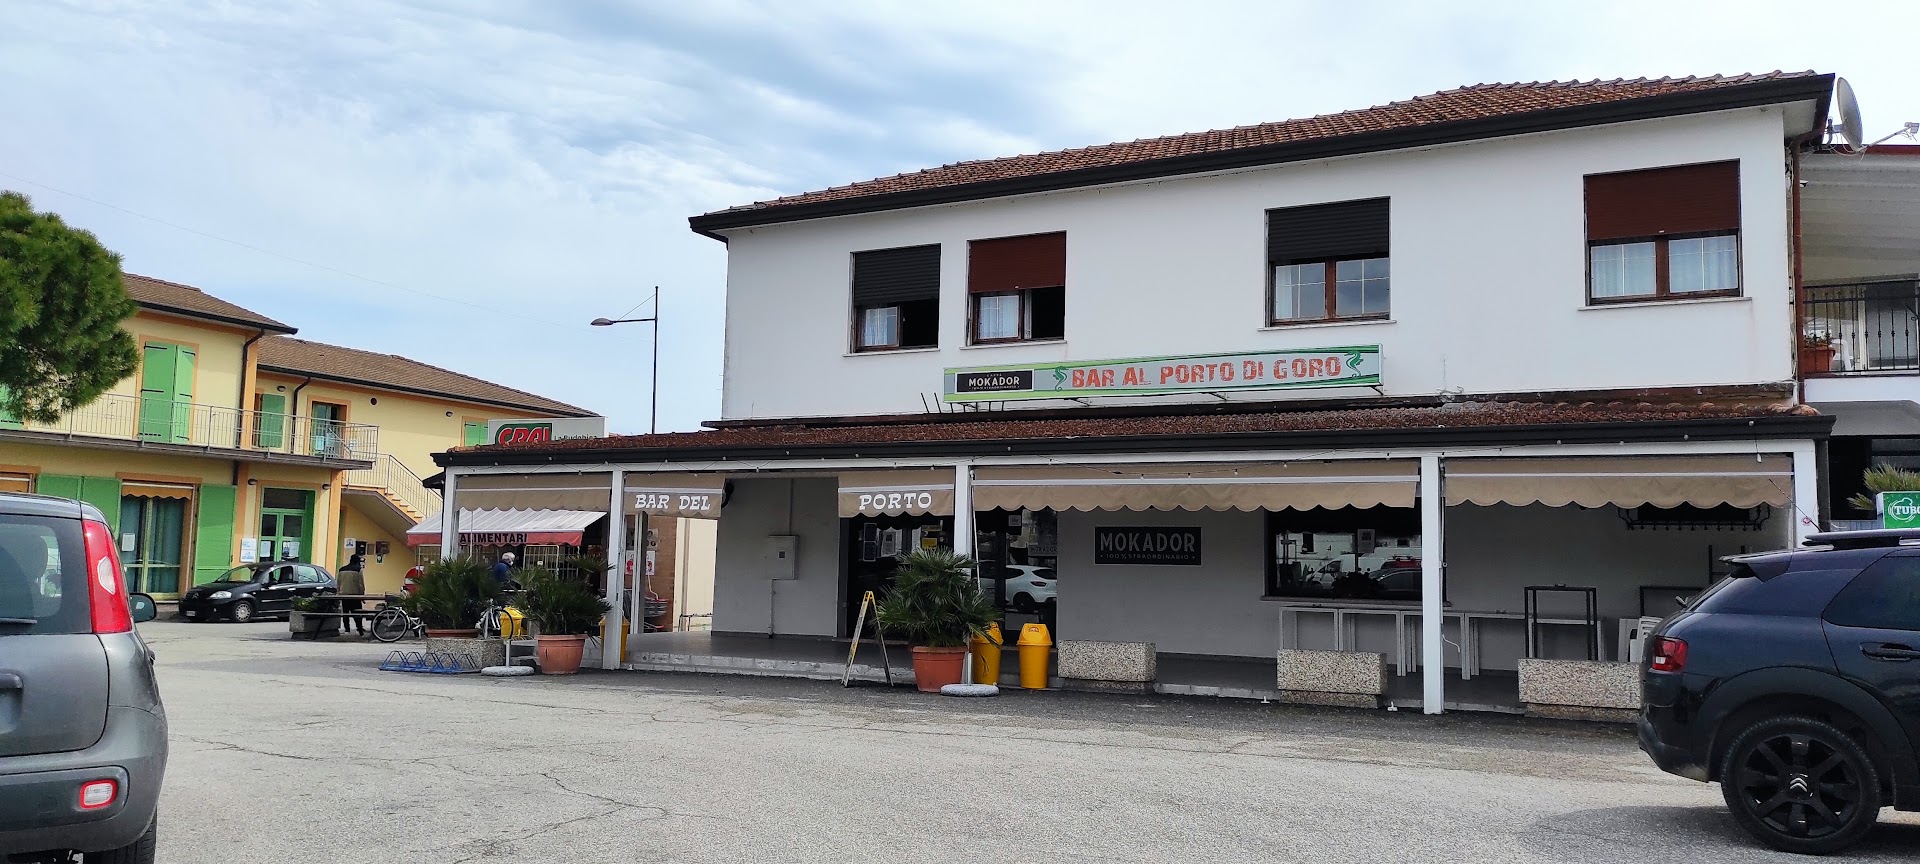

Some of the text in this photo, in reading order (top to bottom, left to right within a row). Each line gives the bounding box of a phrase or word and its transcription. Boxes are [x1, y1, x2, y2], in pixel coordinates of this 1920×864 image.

[1072, 356, 1342, 388] BAR AL PORTO DI GORO
[968, 376, 1021, 387] MOKADOR
[635, 494, 711, 511] BAR DEL
[859, 492, 932, 511] PORTO
[460, 532, 527, 543] ALIMENTARI
[1100, 532, 1195, 552] MOKADOR
